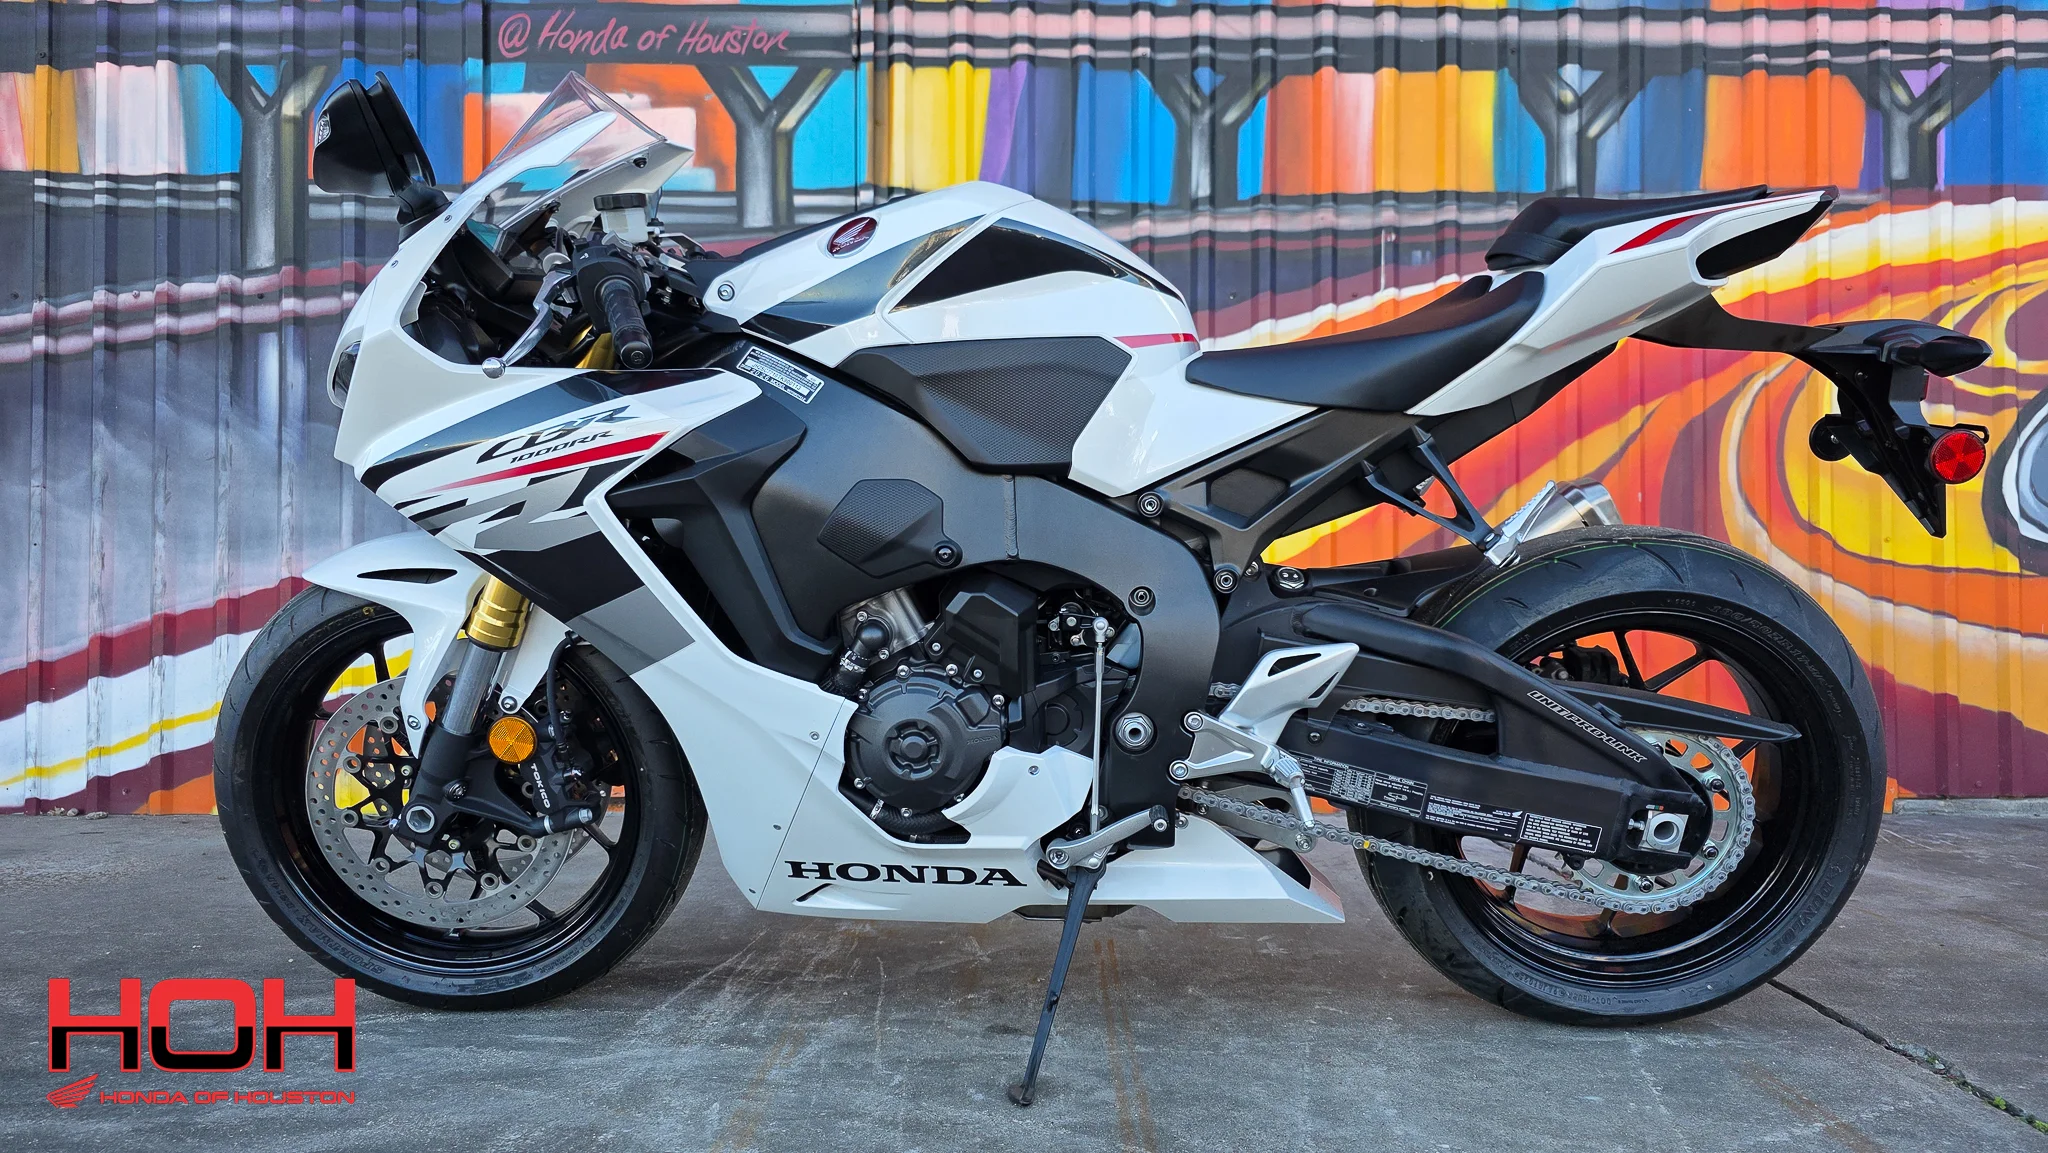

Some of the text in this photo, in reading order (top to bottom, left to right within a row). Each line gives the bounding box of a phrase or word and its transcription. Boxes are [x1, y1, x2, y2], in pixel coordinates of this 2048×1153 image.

[498, 8, 790, 58] @ Honda of Houston
[476, 404, 641, 465] CBR
[510, 430, 614, 464] 1000RR
[1527, 690, 1648, 764] UNIT PRO-LINK
[530, 762, 551, 809] TOKICO
[784, 860, 1028, 887] HONDA
[296, 914, 387, 975] SPORTMAX
